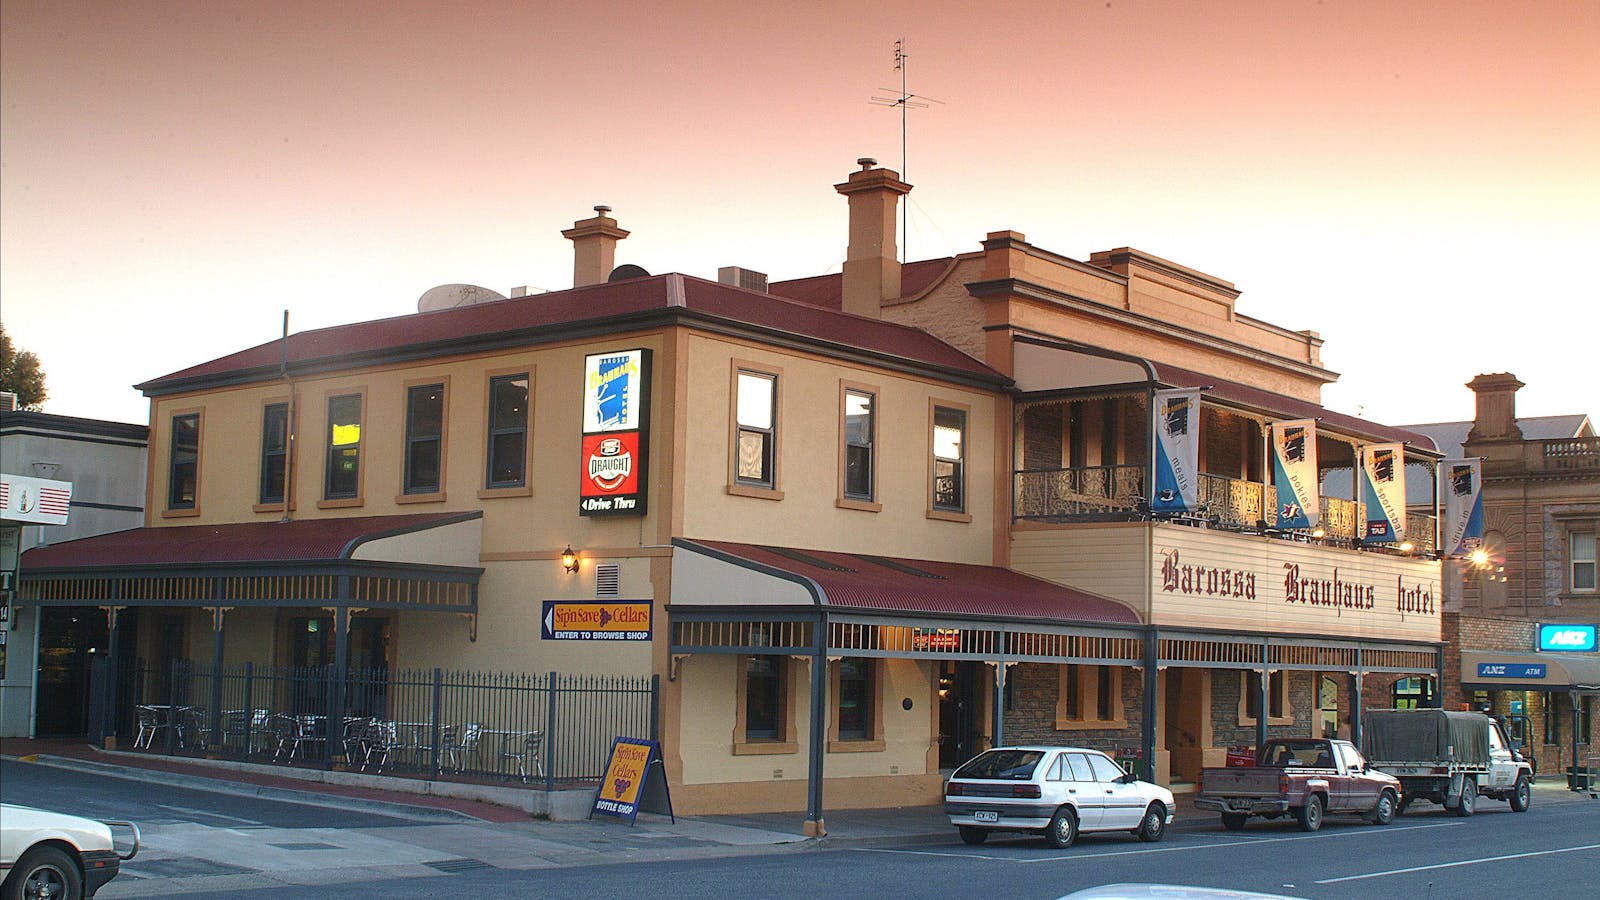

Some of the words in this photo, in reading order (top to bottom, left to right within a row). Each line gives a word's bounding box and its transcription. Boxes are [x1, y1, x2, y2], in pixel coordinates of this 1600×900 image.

[591, 457, 630, 475] DRAUGHT
[1172, 457, 1188, 491] meals
[1290, 475, 1311, 510] pokies
[588, 498, 612, 510] Drive
[614, 497, 636, 509] Thru
[1377, 486, 1402, 533] sportsbar
[1452, 521, 1465, 544] drive
[1462, 510, 1470, 519] in
[1160, 547, 1256, 600] Barossa
[1283, 562, 1375, 617] Brauhaus
[1397, 574, 1435, 622] hotel
[578, 610, 599, 623] Save
[613, 606, 648, 623] Cellars
[581, 631, 591, 639] TO
[593, 631, 625, 639] BROWSE
[1482, 666, 1506, 674] ANZ
[613, 764, 637, 778] Cellars
[596, 801, 617, 812] BOTTLE
[617, 803, 634, 814] SHOP
